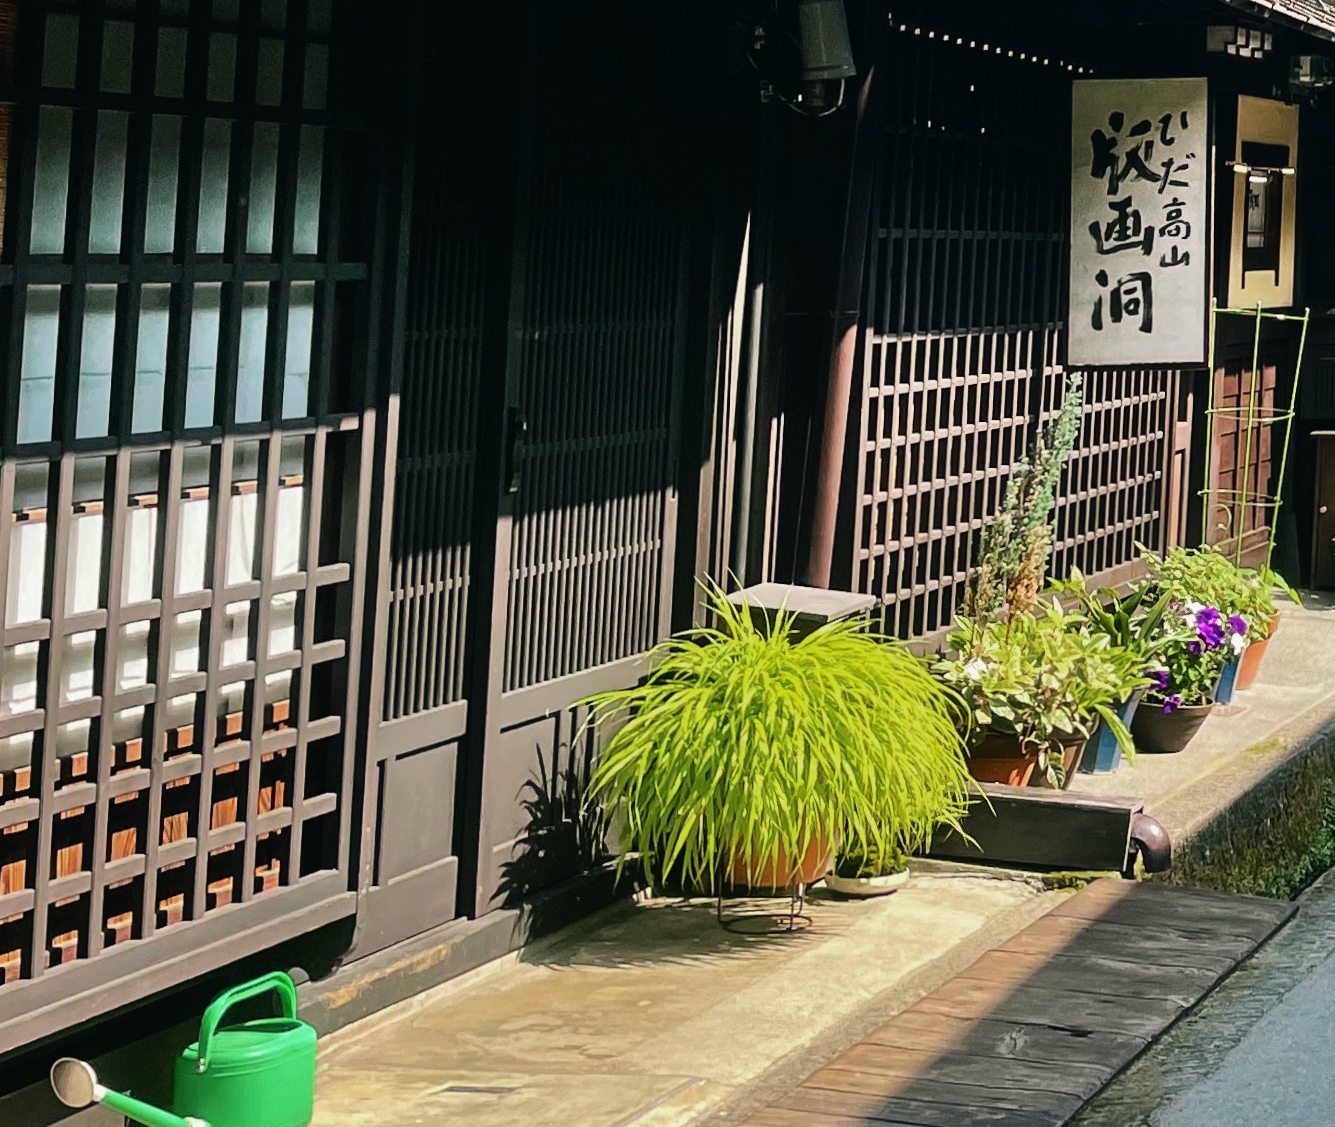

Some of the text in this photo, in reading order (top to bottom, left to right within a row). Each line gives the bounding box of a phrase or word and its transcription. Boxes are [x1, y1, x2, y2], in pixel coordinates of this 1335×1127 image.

[1089, 110, 1161, 334] 版画洞
[1157, 109, 1198, 268] ひだ高山
